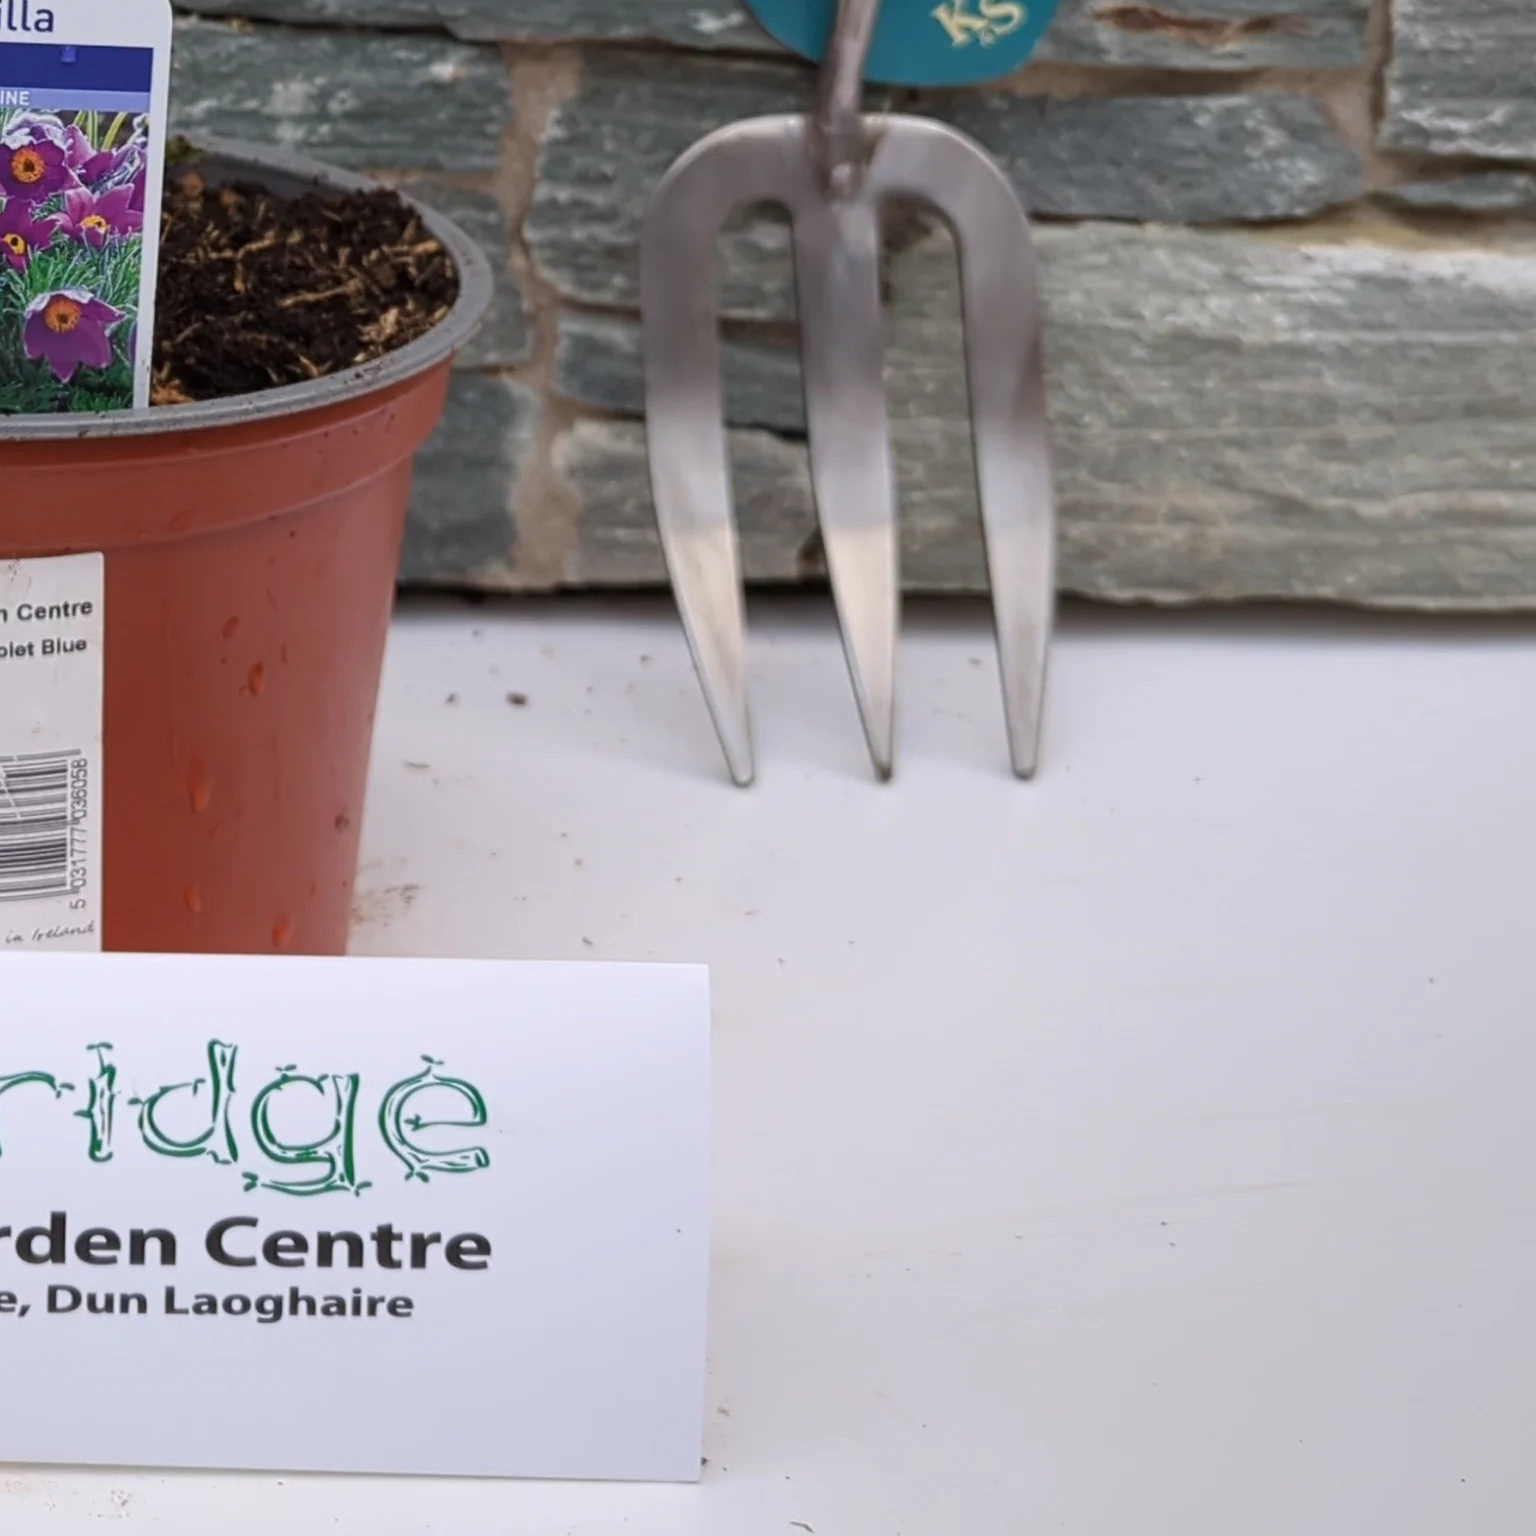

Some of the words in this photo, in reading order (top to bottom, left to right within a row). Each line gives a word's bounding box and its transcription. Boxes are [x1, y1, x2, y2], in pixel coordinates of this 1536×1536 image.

[16, 601, 93, 622] Centre
[41, 637, 88, 655] Blue
[5, 930, 24, 944] in
[31, 920, 95, 942] Ireland
[204, 1215, 492, 1271] Centre
[46, 1283, 148, 1316] Dun
[163, 1285, 414, 1324] Laoghaire
